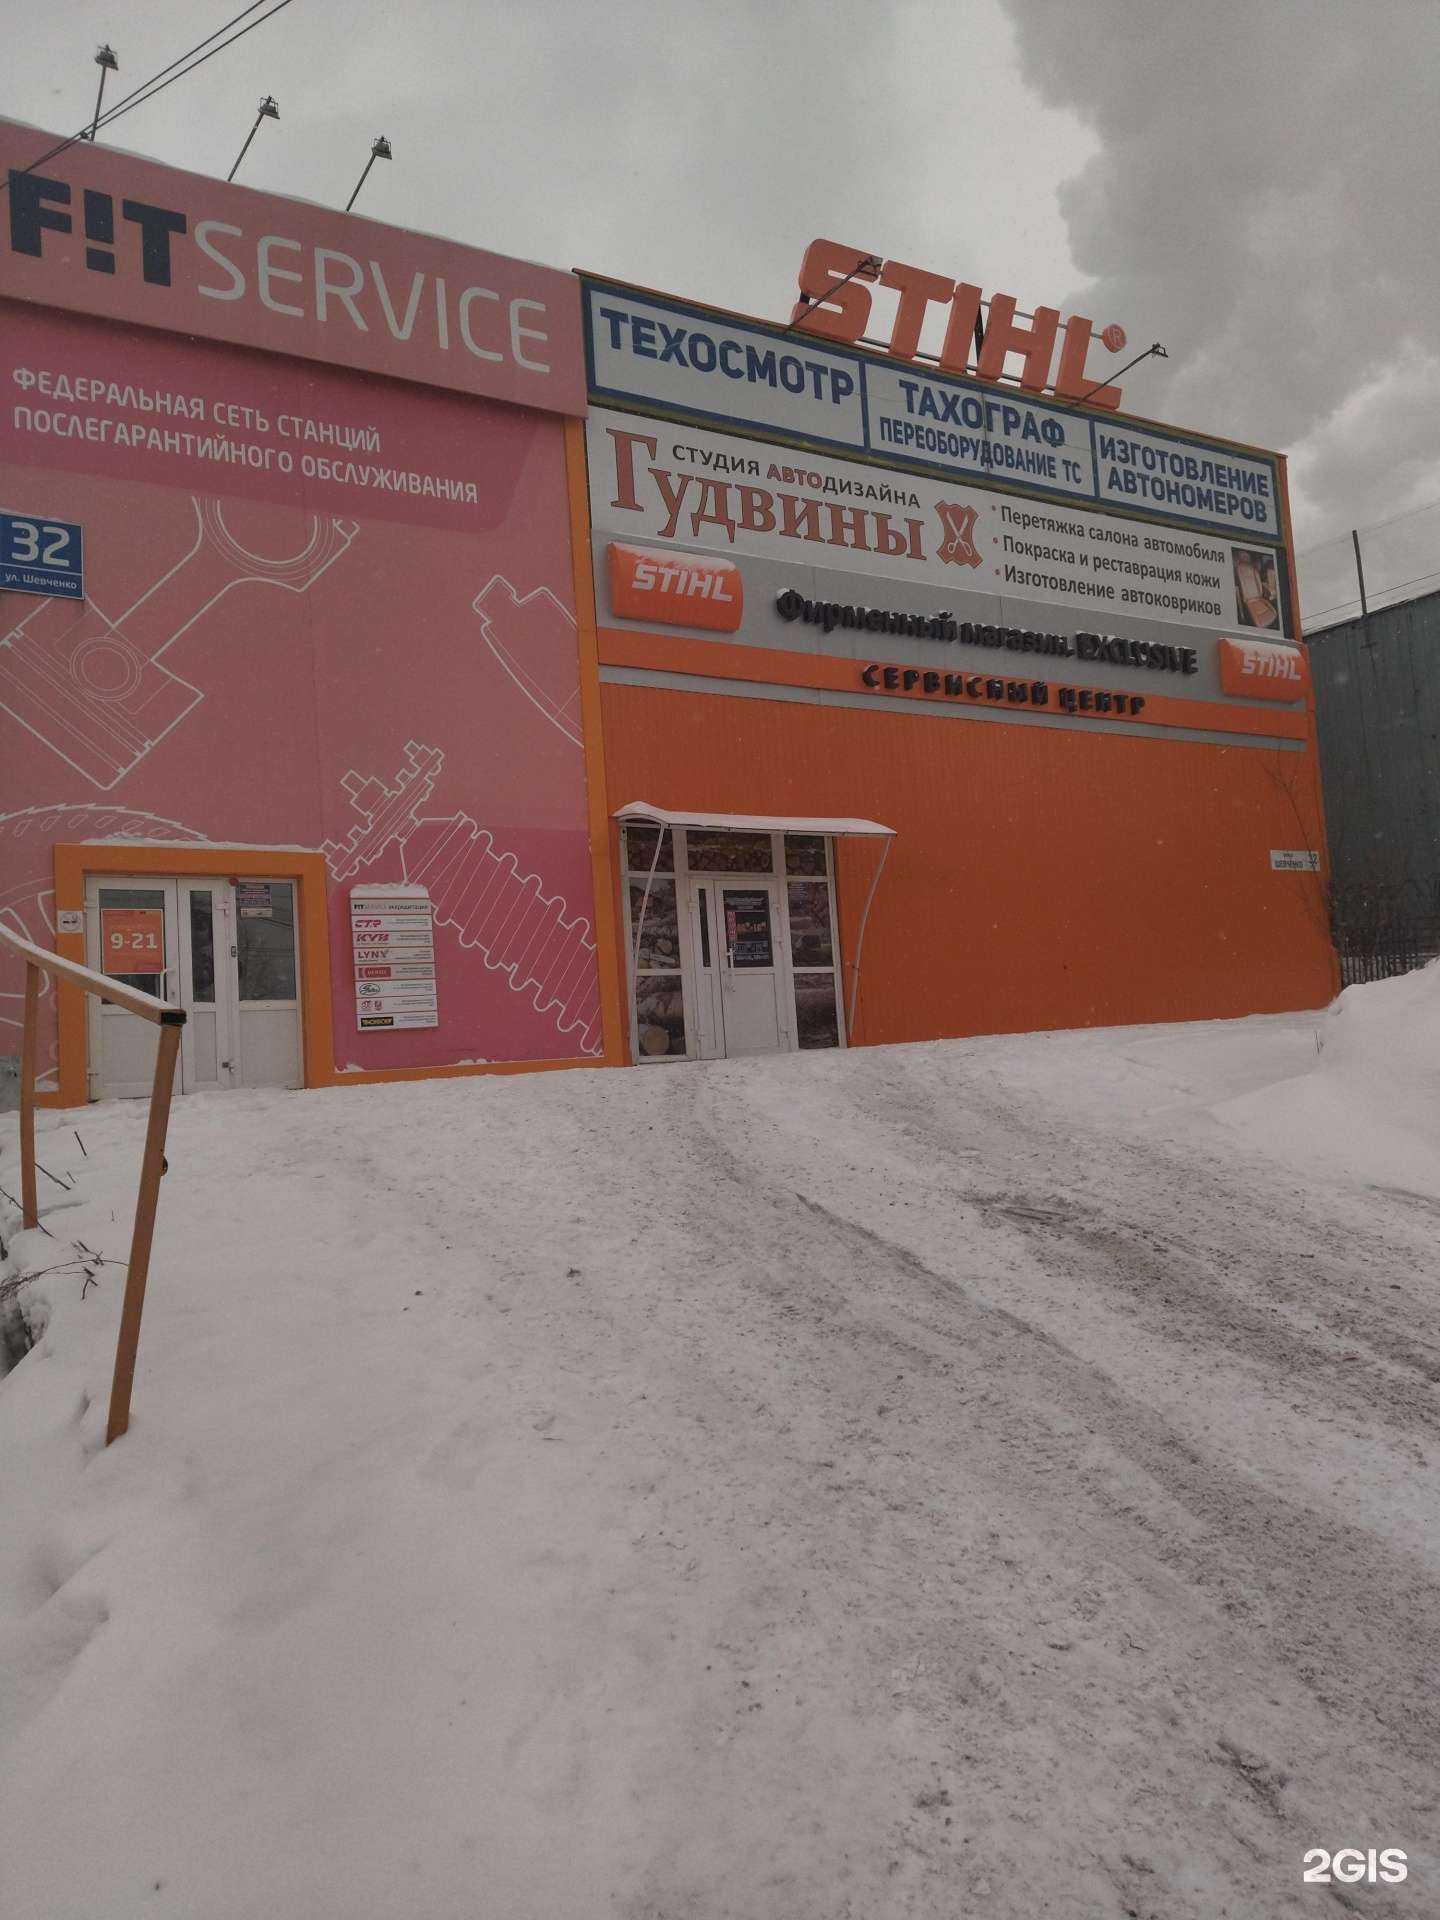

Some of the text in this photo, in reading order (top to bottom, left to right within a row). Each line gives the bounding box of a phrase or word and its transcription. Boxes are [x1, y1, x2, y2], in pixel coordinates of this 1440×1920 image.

[600, 307, 855, 405] ТЕХОСМОТР
[12, 367, 381, 453] ФЕДЕРАЛЬНАЯ СЕТЬ СТАНЦИЙ
[898, 379, 1066, 448] ТАХОГРАФ
[13, 406, 478, 504] ПОСЛЕГАРАНТИЙНОГО ОБСЛУЖИВАНИЯ
[671, 444, 921, 509] СТУДИЯ АВТОДИЗАЙНА
[879, 416, 1083, 485] ПЕРЕОБОРУДОВАНИЕ ТС
[1099, 434, 1270, 498] ИЗГОТОВЛЕНИЕ
[1108, 466, 1268, 523] АВТОНОМЕРОВ
[11, 521, 70, 567] 32
[1000, 505, 1225, 564] Перетяжка салона автомобиля
[1003, 535, 1221, 589] Покраска и реставрация кожи
[23, 574, 77, 590] Шевченко
[631, 563, 734, 602] STIHL
[1004, 564, 1222, 616] Изготовление автоковриков
[861, 664, 1146, 716] СЕРВИСНЫЙ ЦЕНТР
[1240, 654, 1302, 681] STIHL
[110, 931, 159, 950] 9-21
